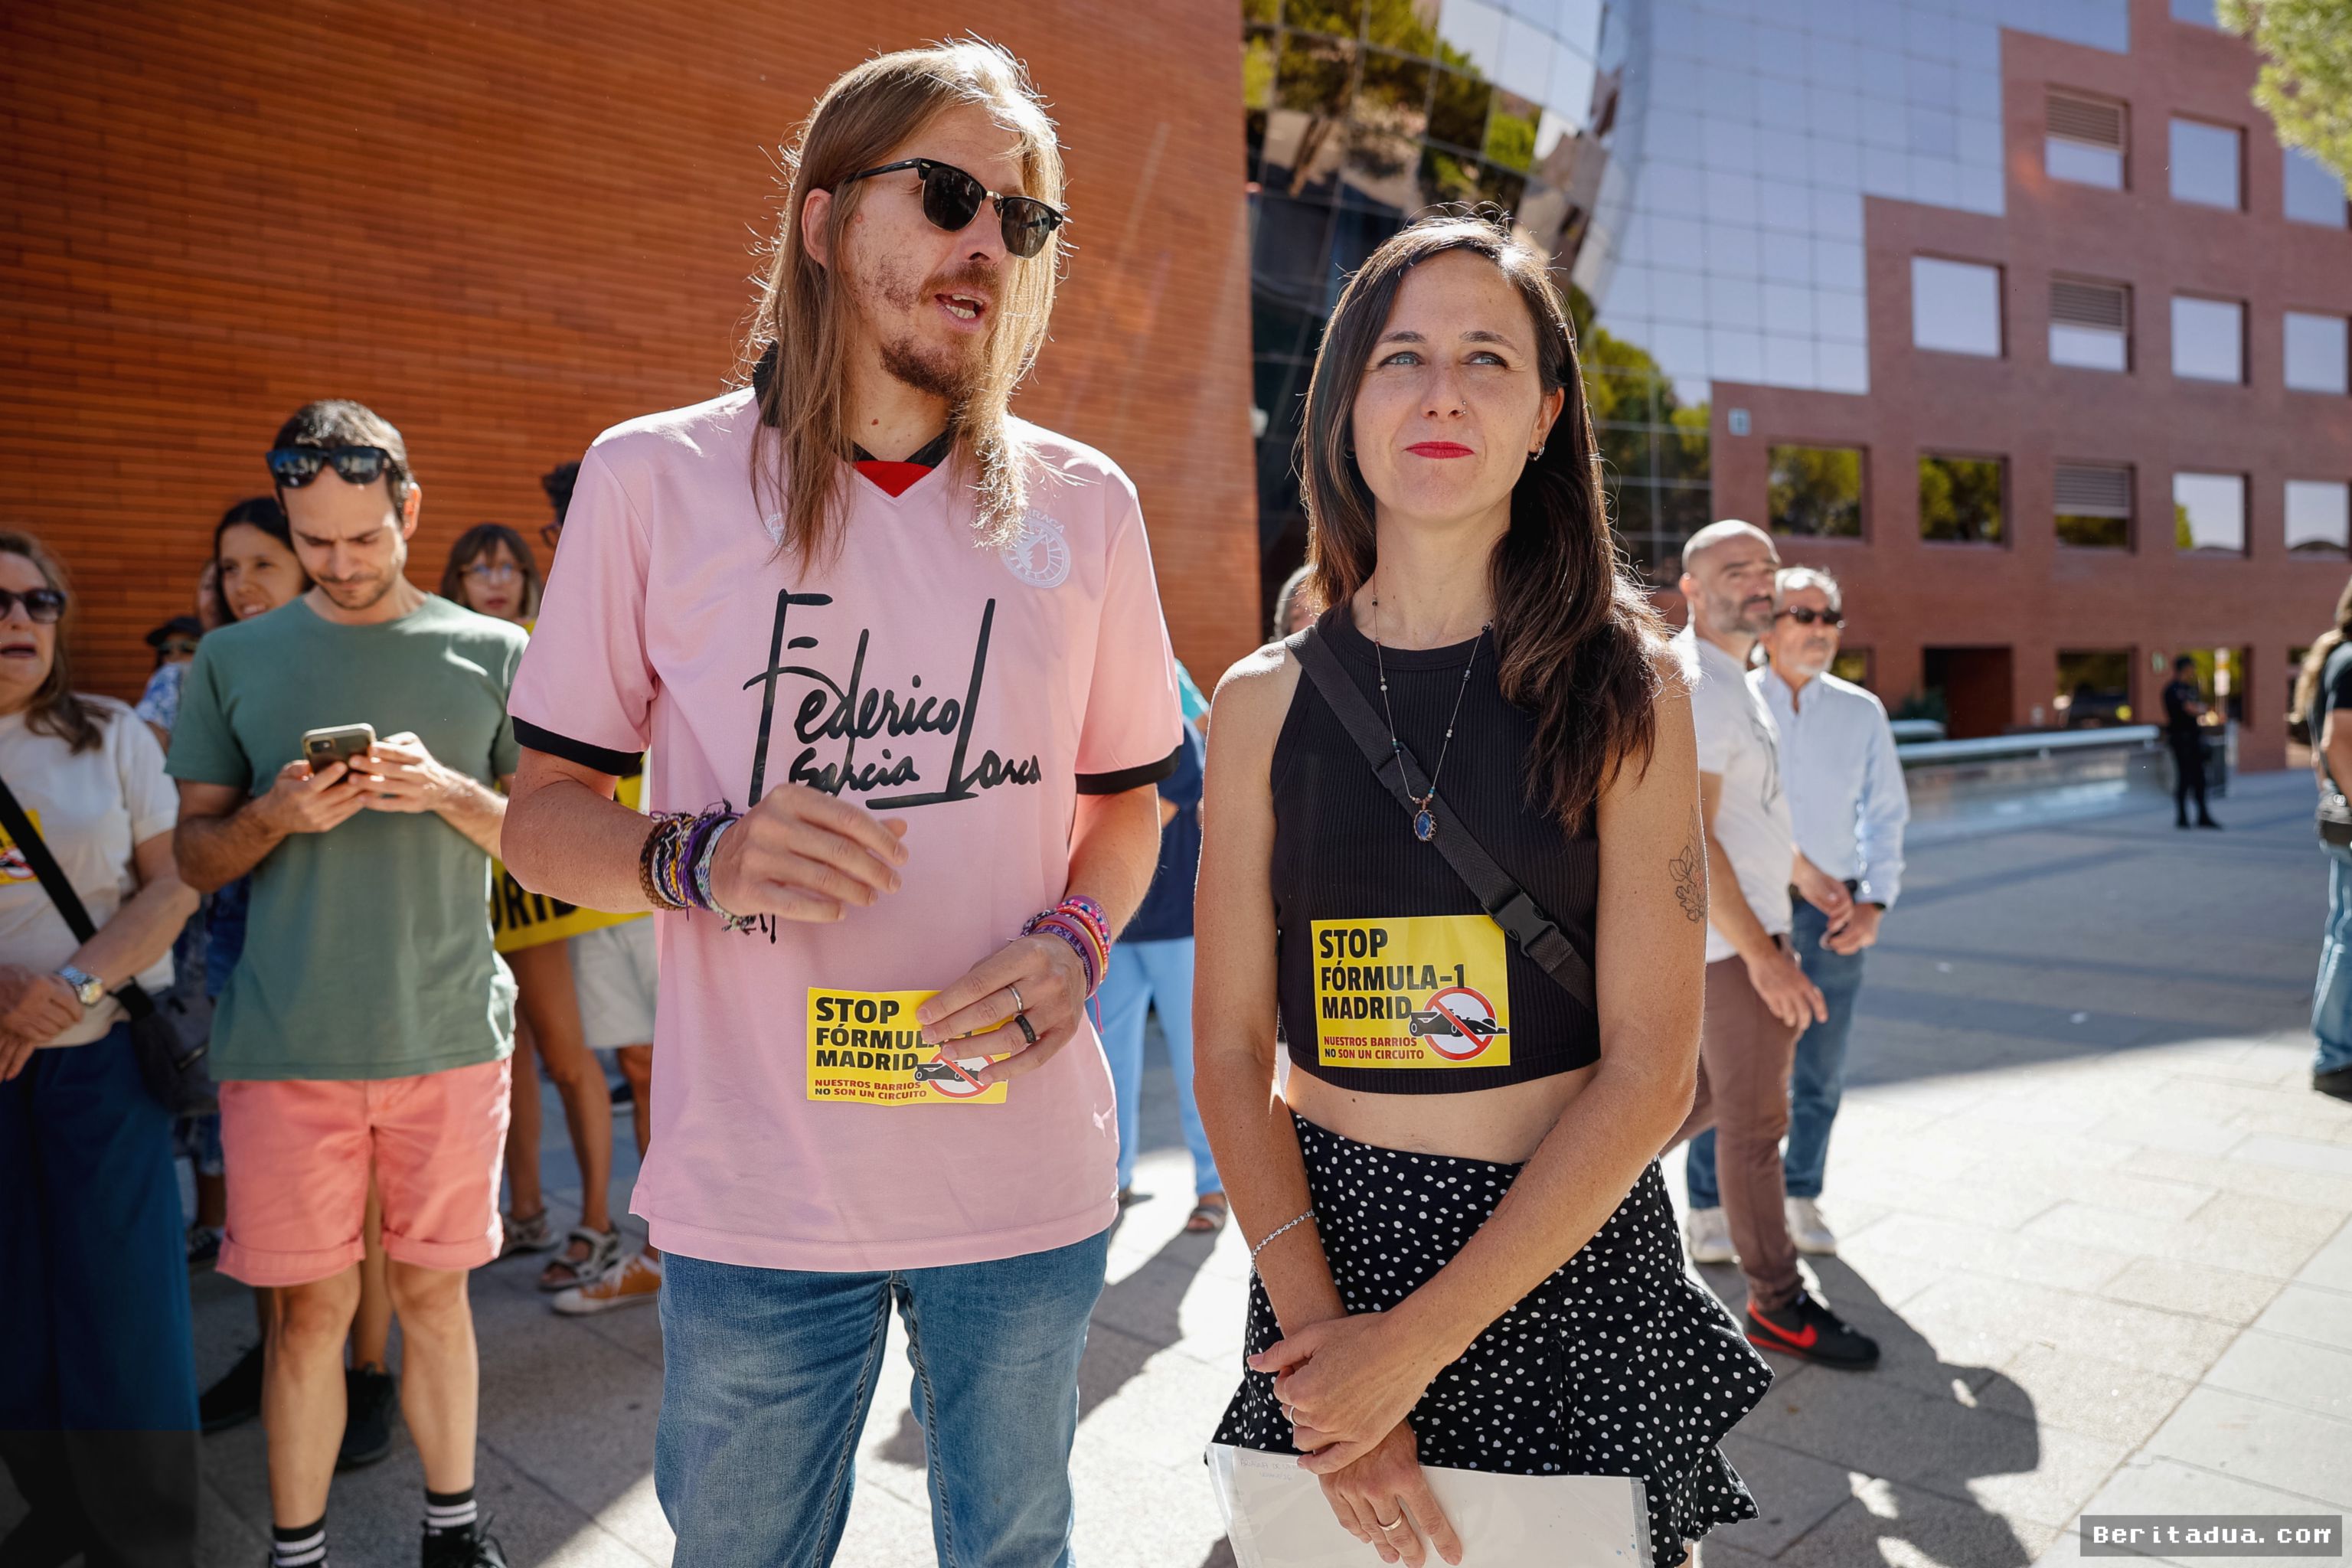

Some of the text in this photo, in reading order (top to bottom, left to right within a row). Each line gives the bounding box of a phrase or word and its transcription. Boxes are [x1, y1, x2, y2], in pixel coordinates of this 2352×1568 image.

[743, 589, 961, 808] Federico
[1319, 928, 1388, 959] STOP
[1321, 960, 1465, 991] FÓRMULA-1
[815, 997, 900, 1024] STOP
[1322, 996, 1412, 1020] MADRID
[1324, 1036, 1417, 1047] NUESTROS BARRIOS
[815, 1050, 919, 1071] MADRID
[1325, 1048, 1424, 1060] NO SON UN CIRCUITO
[815, 1080, 921, 1091] NUESTROS BARRIOS
[834, 1089, 857, 1097] SON
[860, 1089, 874, 1098] UN
[877, 1090, 926, 1099] CIRCUITO
